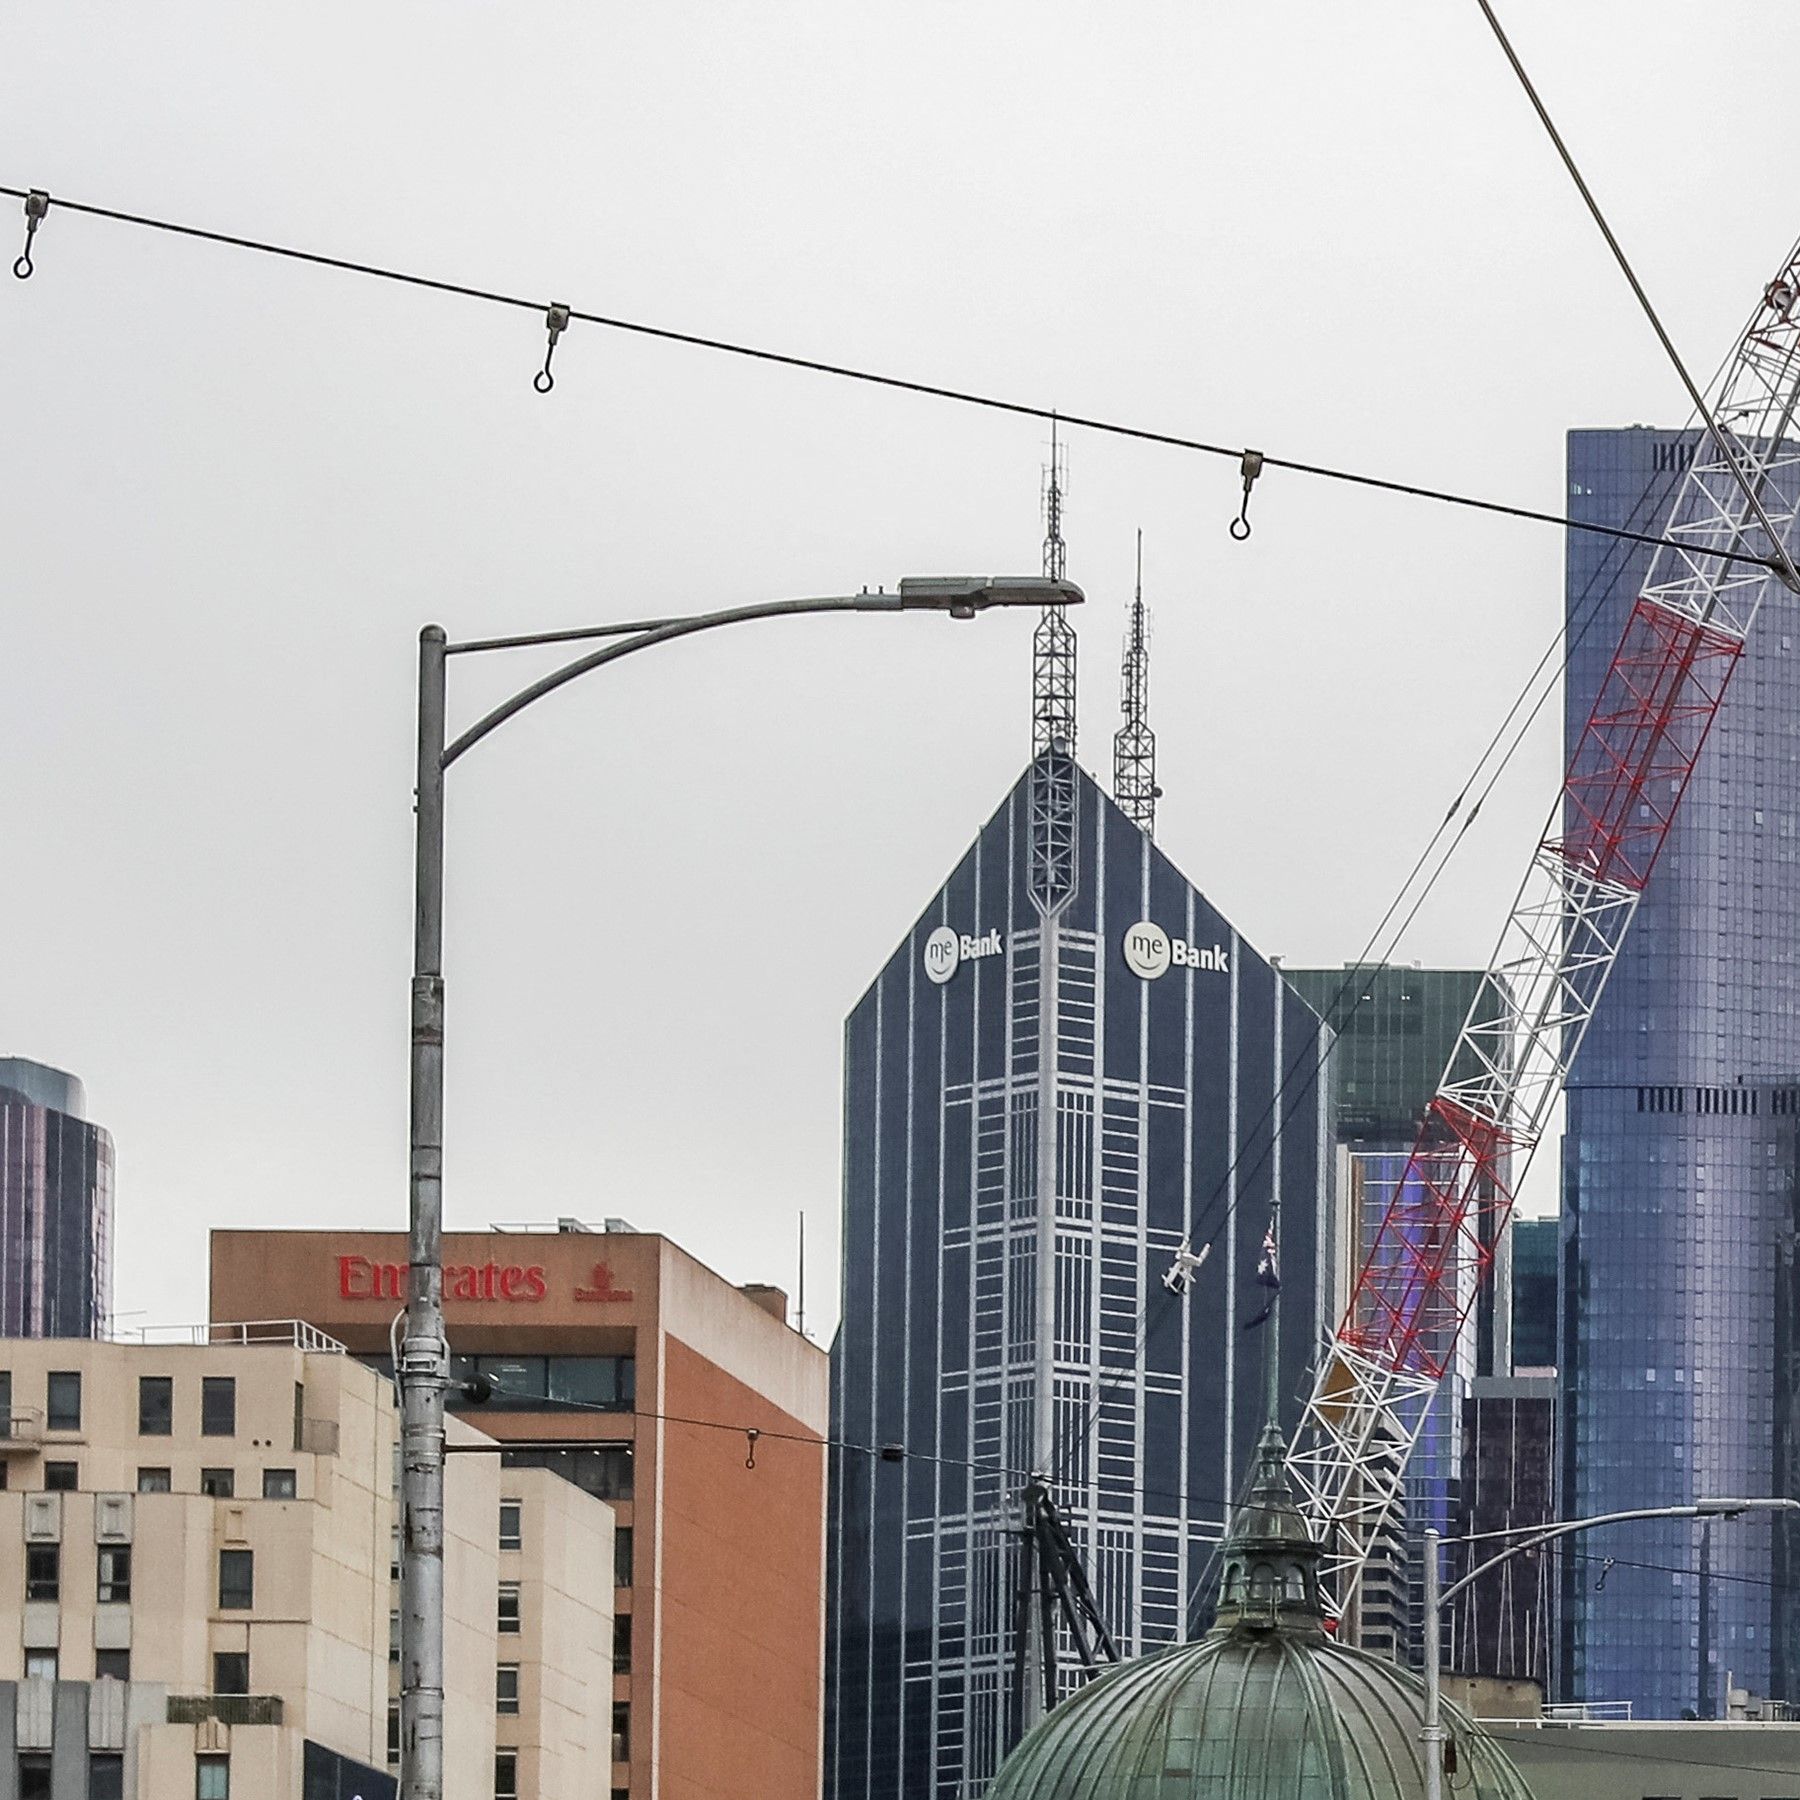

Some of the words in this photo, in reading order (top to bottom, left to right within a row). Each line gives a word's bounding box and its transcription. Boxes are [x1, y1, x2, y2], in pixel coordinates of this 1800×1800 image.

[960, 928, 1003, 962] Bank
[1132, 933, 1163, 967] me
[1171, 939, 1230, 973] Bank
[338, 1255, 548, 1301] Emrates
